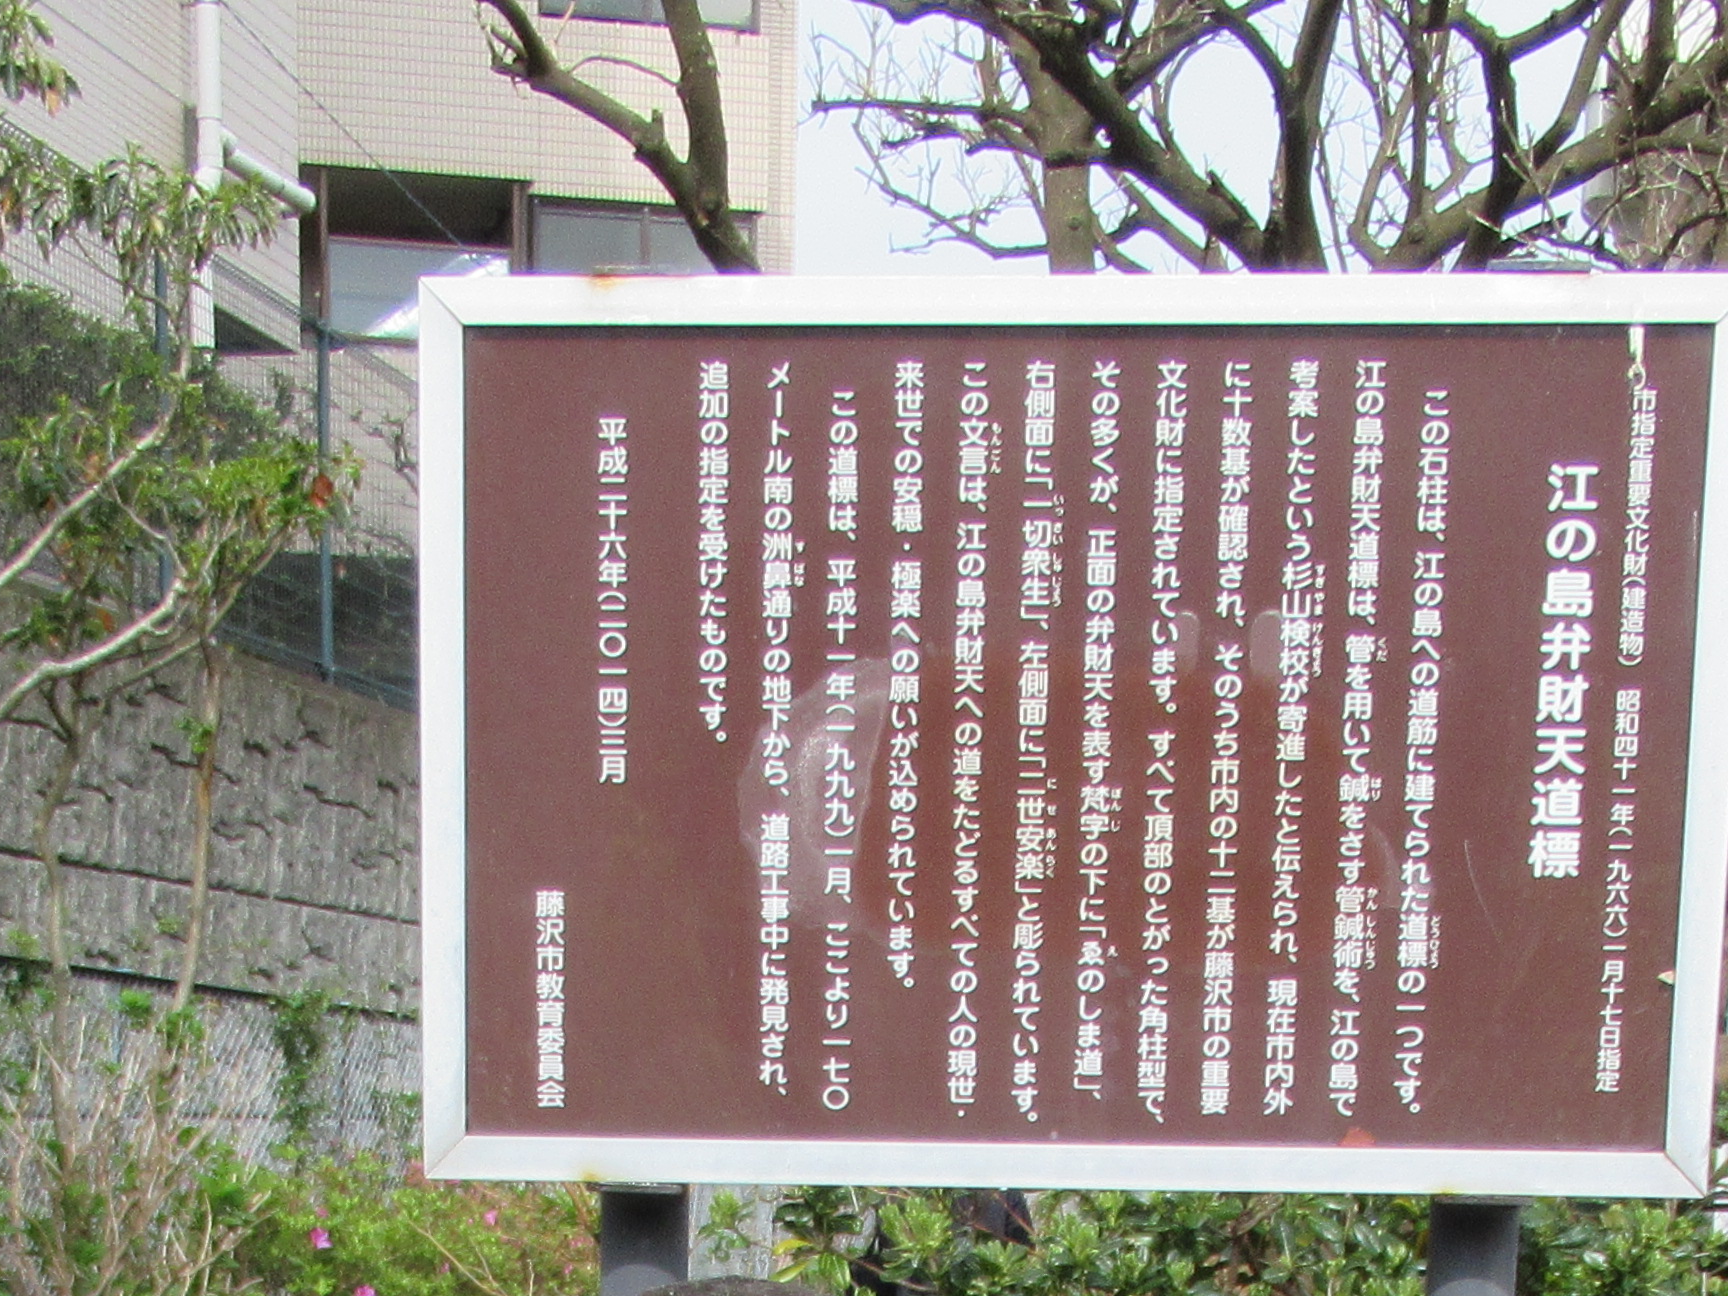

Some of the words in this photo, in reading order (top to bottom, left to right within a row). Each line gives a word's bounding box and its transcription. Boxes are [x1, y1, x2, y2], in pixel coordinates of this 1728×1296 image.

[698, 360, 729, 742] 追加の指定を受けたものです。
[1527, 463, 1599, 878] 江の島弁財天道標
[535, 889, 566, 1108] 藤沢市教育委員会
